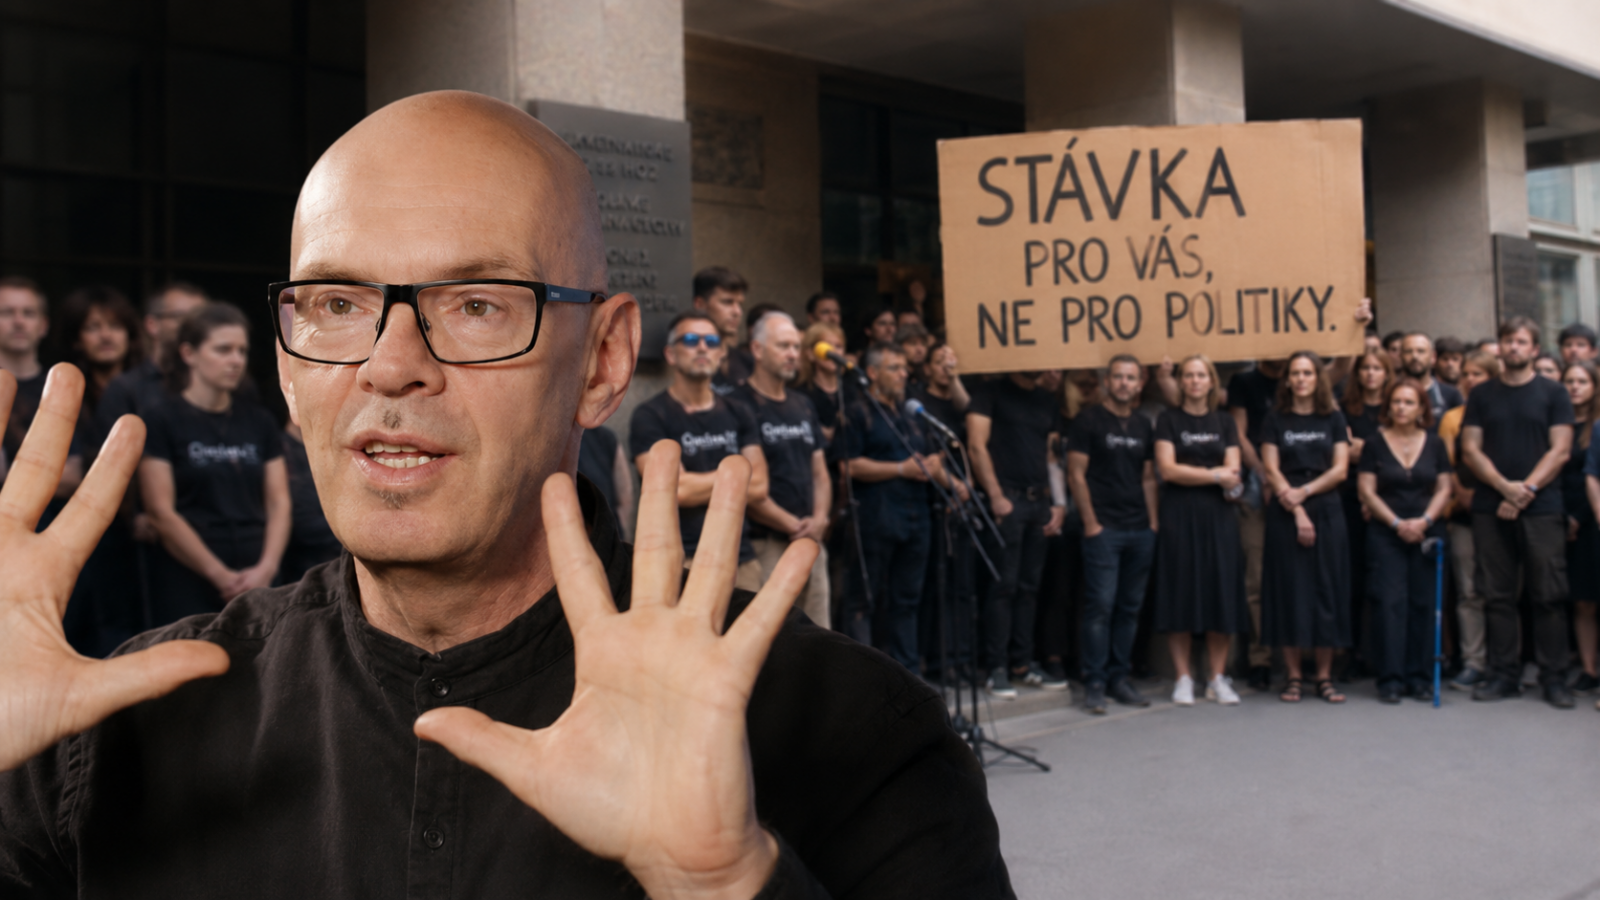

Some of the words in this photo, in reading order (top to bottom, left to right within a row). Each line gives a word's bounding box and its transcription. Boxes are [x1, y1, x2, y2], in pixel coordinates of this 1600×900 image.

[976, 136, 1247, 226] STÁVKA
[1024, 237, 1109, 287] PRO
[1126, 224, 1214, 284] VÁS,
[977, 299, 1036, 349] NE
[1061, 294, 1142, 344] PRO
[1165, 285, 1337, 339] POLITIKY.
